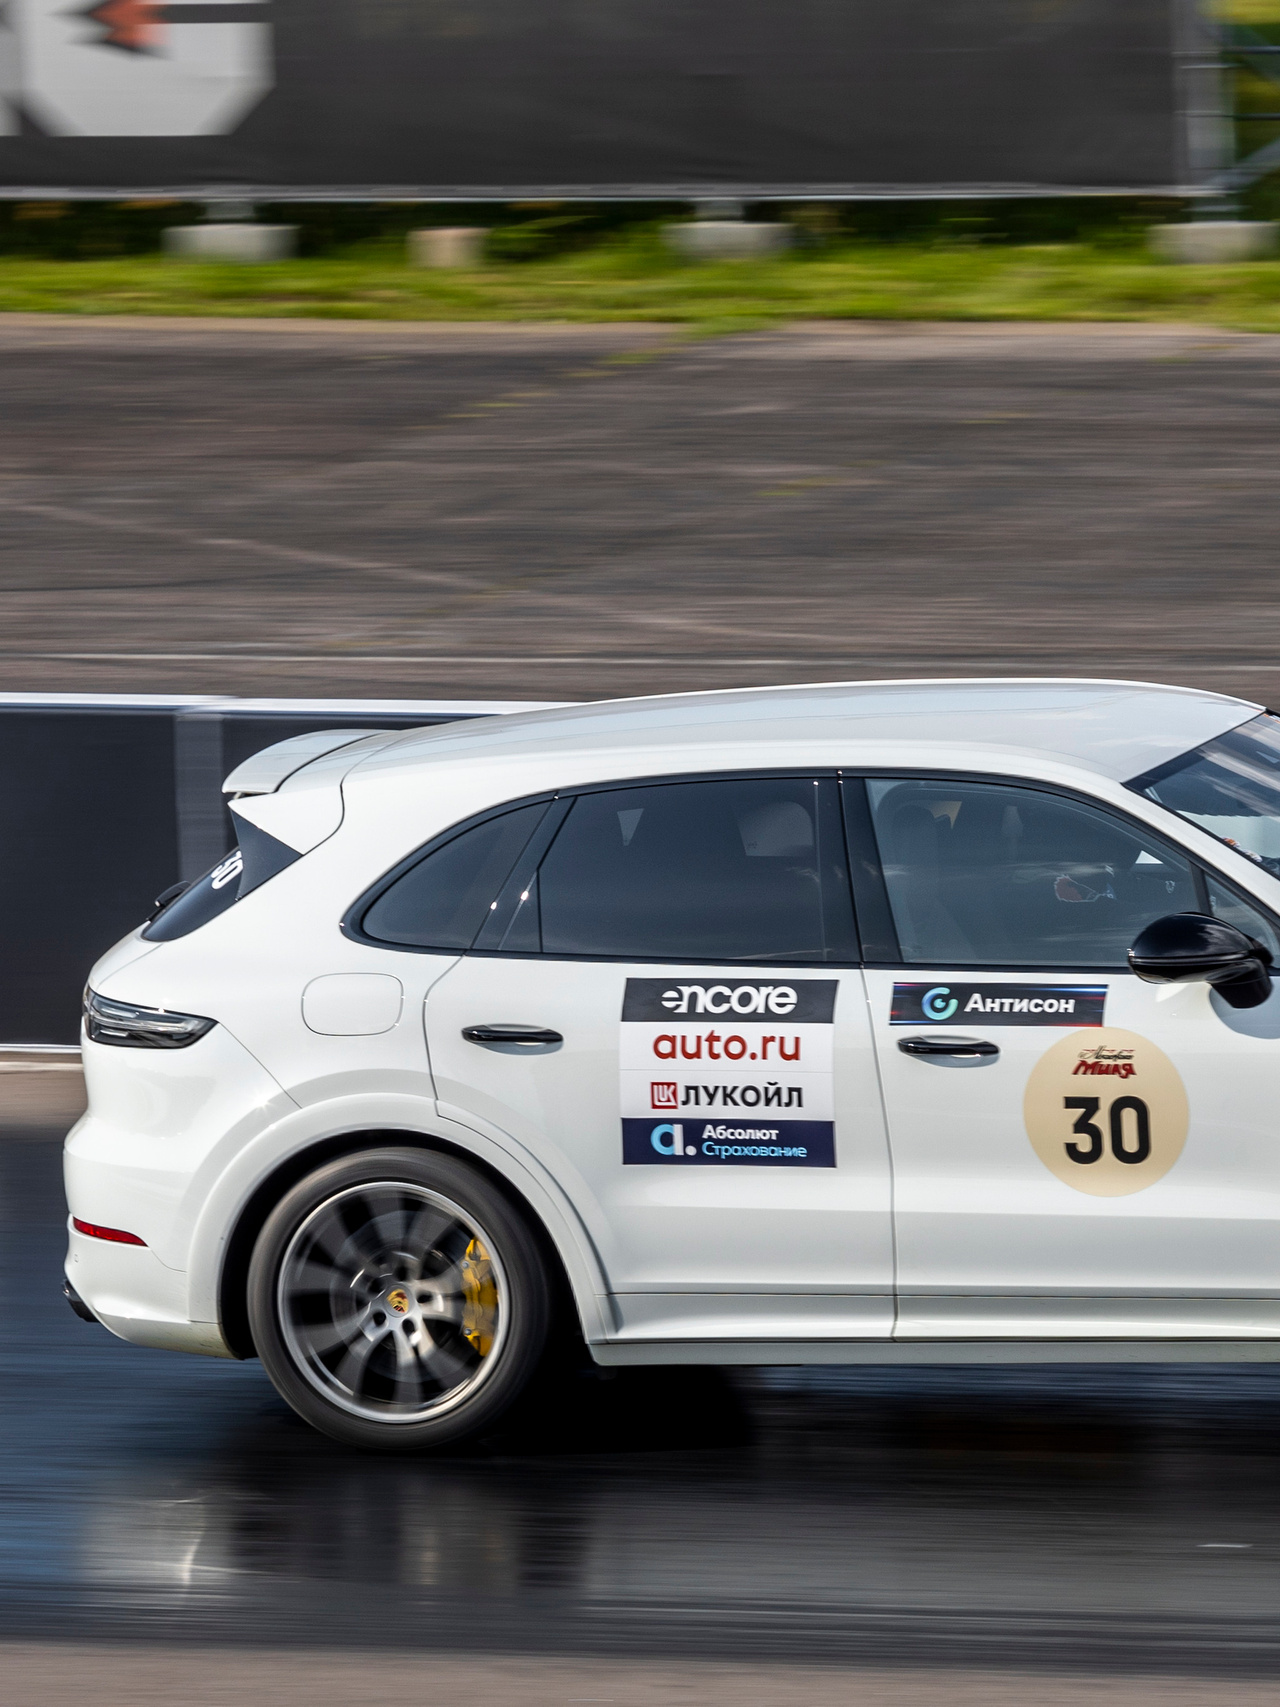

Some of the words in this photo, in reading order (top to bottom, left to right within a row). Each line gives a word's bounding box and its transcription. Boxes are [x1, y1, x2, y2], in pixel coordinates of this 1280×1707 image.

[661, 985, 798, 1014] encore
[964, 993, 1075, 1013] Антисон
[653, 1030, 800, 1060] auto.ru
[681, 1081, 803, 1107] ЛУКОЙЛ
[702, 1124, 779, 1140] Абсолют
[1063, 1095, 1151, 1165] 30
[702, 1141, 808, 1159] Страхование
